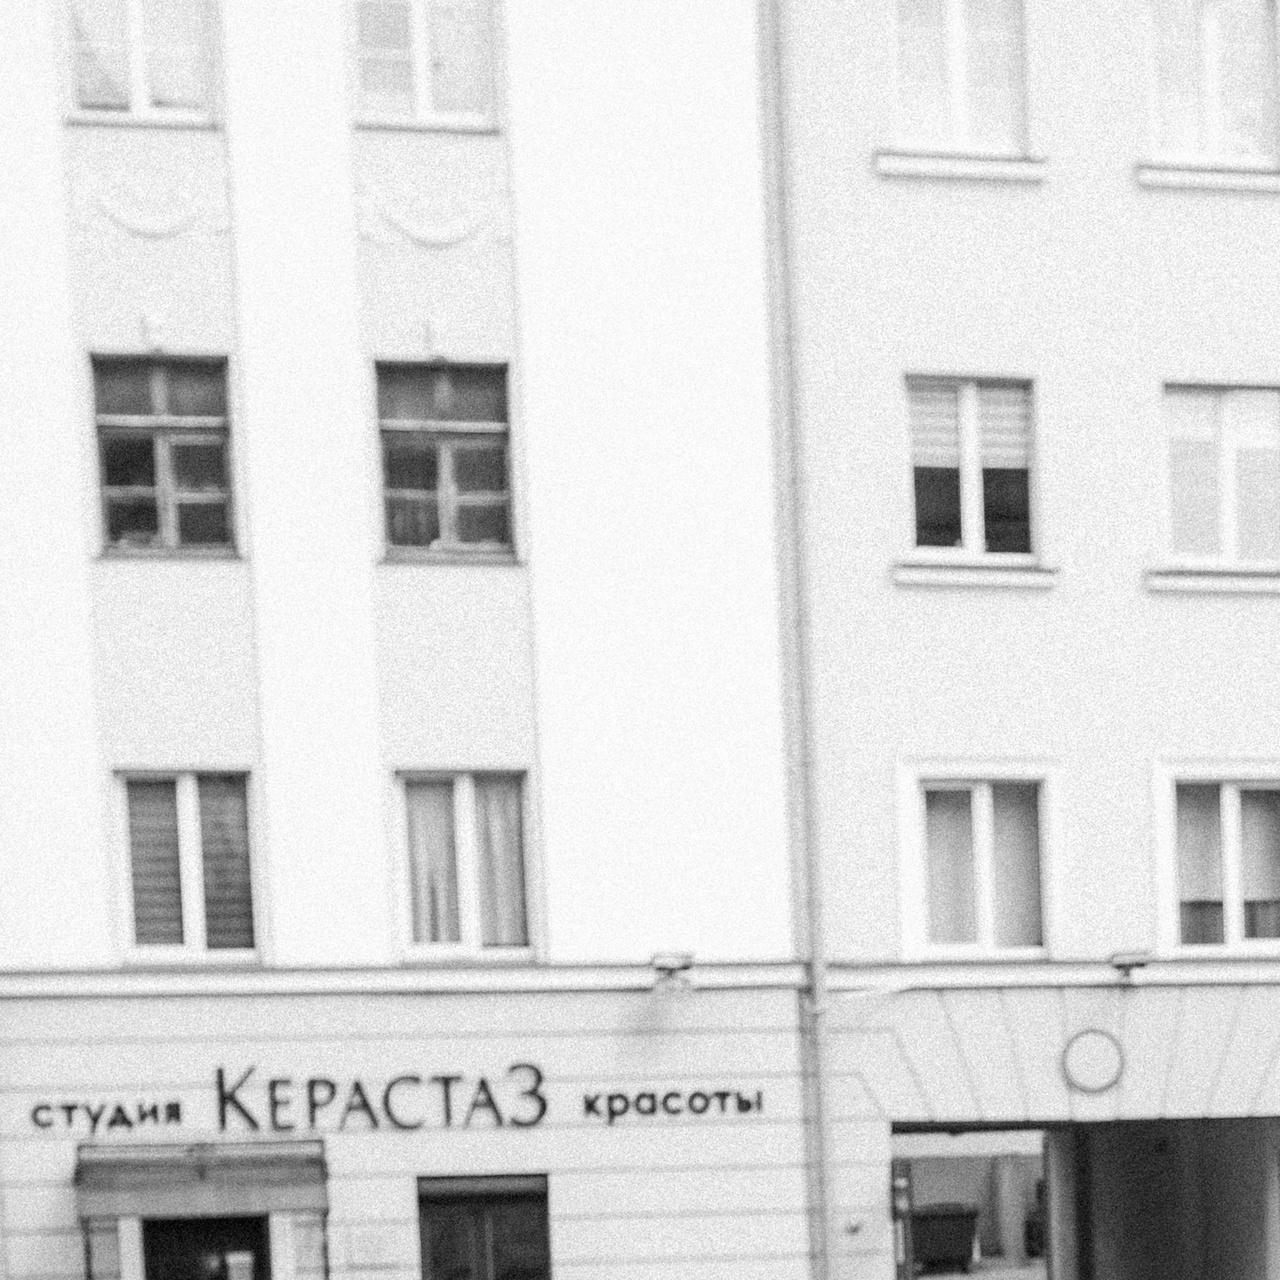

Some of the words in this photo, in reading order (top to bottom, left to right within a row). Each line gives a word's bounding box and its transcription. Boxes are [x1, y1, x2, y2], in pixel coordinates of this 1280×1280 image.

[31, 1103, 181, 1133] студия
[216, 1063, 547, 1131] КЕРАСТАЗ
[584, 1090, 763, 1126] красоты
